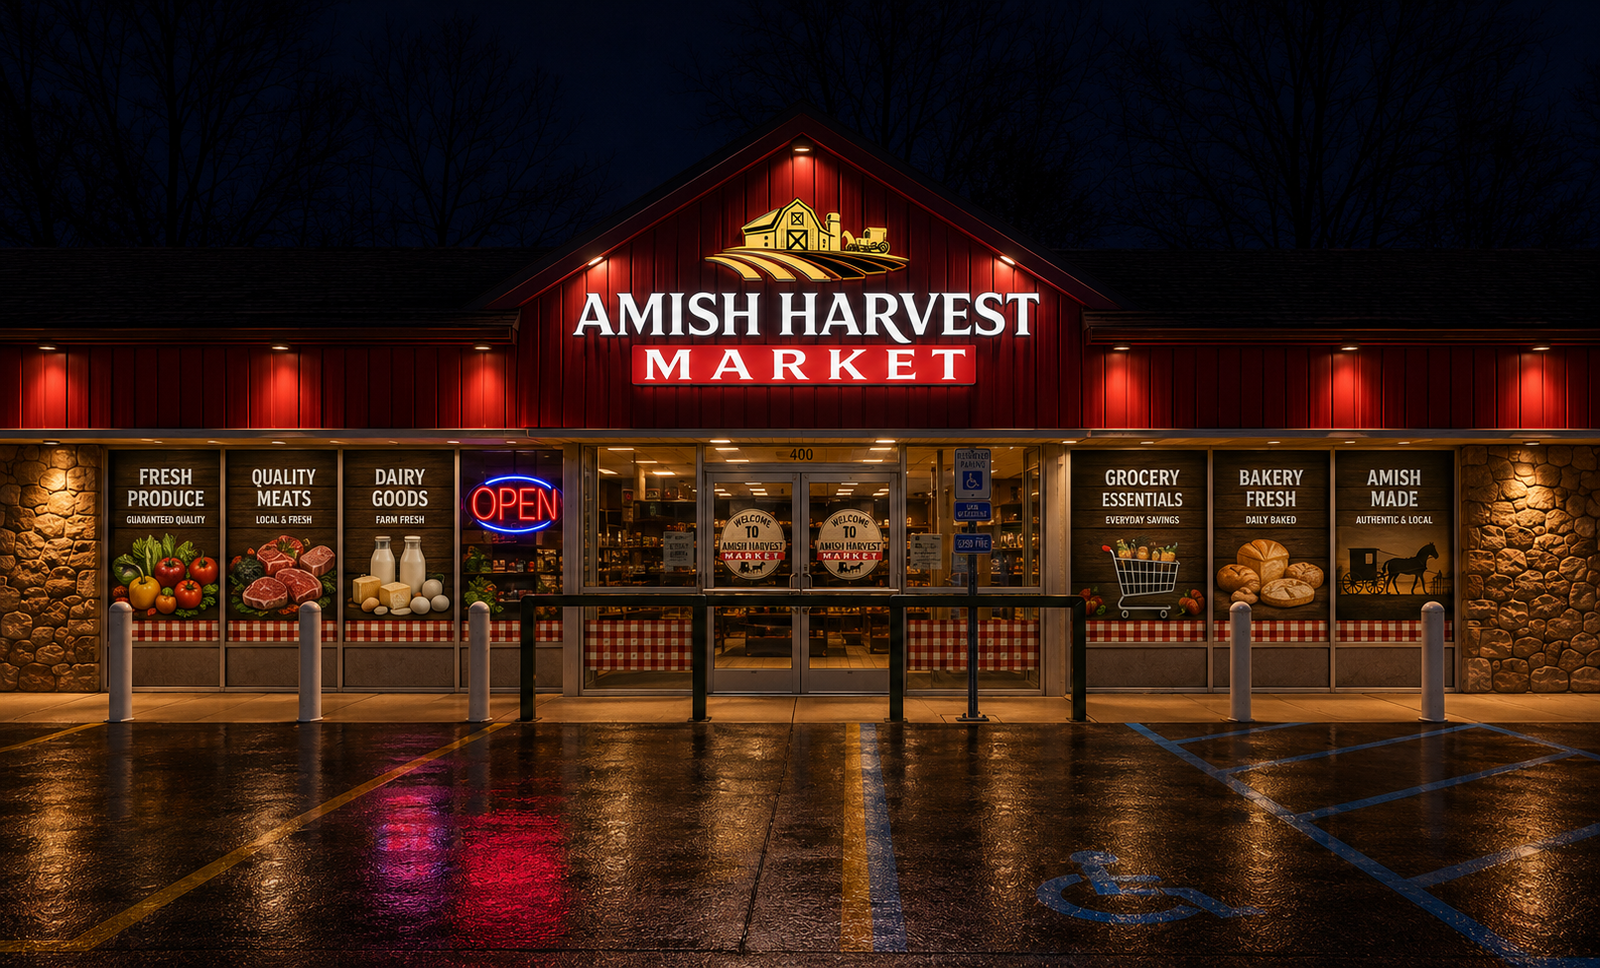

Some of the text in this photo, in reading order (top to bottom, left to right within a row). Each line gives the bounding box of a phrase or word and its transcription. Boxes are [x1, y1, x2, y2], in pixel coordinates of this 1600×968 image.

[573, 292, 1039, 343] AMISH HARVEST
[645, 349, 965, 379] MARKET
[790, 449, 813, 460] 400
[140, 469, 191, 485] FRESH
[252, 469, 315, 487] QUALITY
[376, 469, 425, 485] DAIRY
[1106, 470, 1179, 485] GROCERY
[1240, 470, 1303, 485] BAKERY
[1367, 470, 1420, 485] AMISH
[128, 490, 204, 506] PRODUCE
[258, 490, 311, 506] MEATS
[373, 490, 428, 506] GOODS
[472, 487, 557, 520] OPEN
[1103, 493, 1182, 506] ESSENTIALS
[1247, 491, 1295, 507] FRESH
[1371, 491, 1418, 506] MADE
[126, 515, 206, 526] GUARANTEED QUALITY
[255, 515, 312, 525] LOCAL & FRESH
[375, 515, 425, 524] FARM FRESH
[733, 515, 771, 528] WELCOME
[831, 515, 869, 528] WELCOME
[1105, 515, 1180, 525] EVERYDAY SAVINGS
[1245, 515, 1297, 525] DAILY BAKED
[1355, 515, 1433, 525] AUTHENTIC & LOCAL
[745, 526, 759, 538] TO
[843, 526, 856, 538] TO
